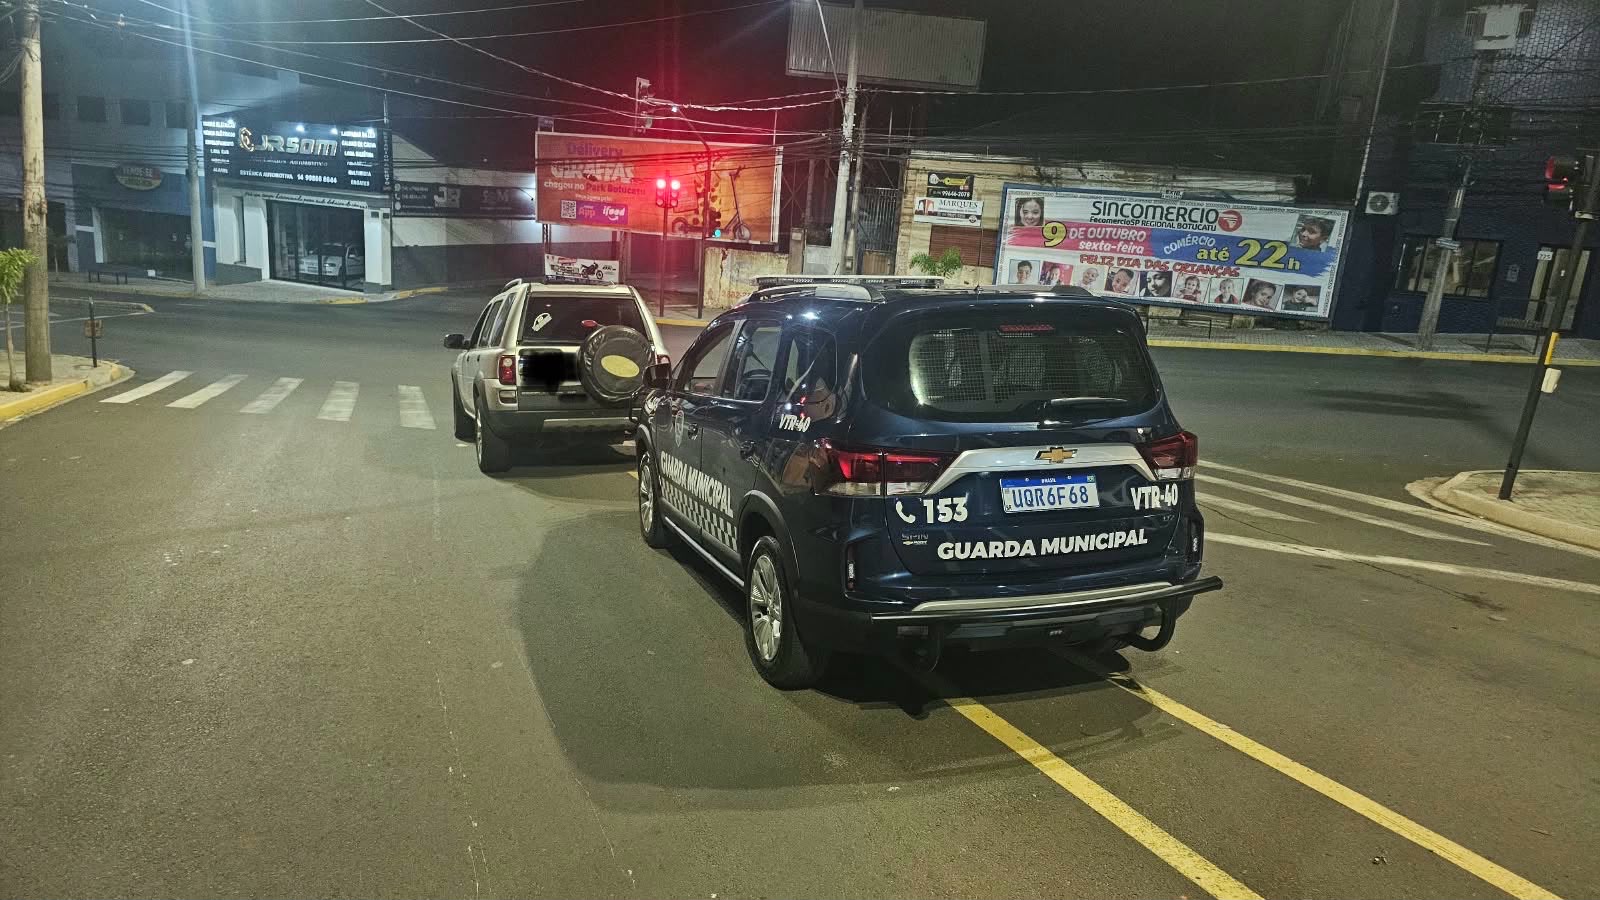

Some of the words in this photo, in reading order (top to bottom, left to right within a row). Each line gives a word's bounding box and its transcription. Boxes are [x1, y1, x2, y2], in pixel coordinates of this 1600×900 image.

[568, 142, 624, 159] Delivery
[544, 179, 573, 191] chegou
[586, 182, 606, 193] Park
[938, 199, 978, 208] MARQUES
[1090, 200, 1220, 224] SINCOMERCIO
[1042, 220, 1068, 248] 9
[1069, 228, 1090, 240] DE
[1092, 228, 1147, 242] OUTUBRO
[1089, 216, 1140, 226] FecomercioSP
[1141, 220, 1176, 229] REGIONAL
[1176, 222, 1217, 232] BOTUCATU
[1078, 239, 1144, 254] sexta-feira
[1163, 234, 1216, 255] COMÉRCIO
[1196, 245, 1230, 262] até
[1234, 238, 1289, 270] 22
[1287, 256, 1301, 270] h
[1080, 254, 1115, 266] FELIZ
[1116, 256, 1142, 268] DIA
[1144, 258, 1170, 272] DAS
[1172, 261, 1240, 278] CRIANÇAS
[778, 413, 812, 432] VTR-40
[660, 450, 688, 490] GUARDA
[686, 466, 734, 518] MUNICIPAL
[1011, 486, 1090, 507] UQR6F68
[1130, 484, 1178, 510] VTR-40
[922, 496, 968, 524] 153
[937, 540, 1036, 560] GUARDA
[1040, 528, 1148, 554] MUNICIPAL
